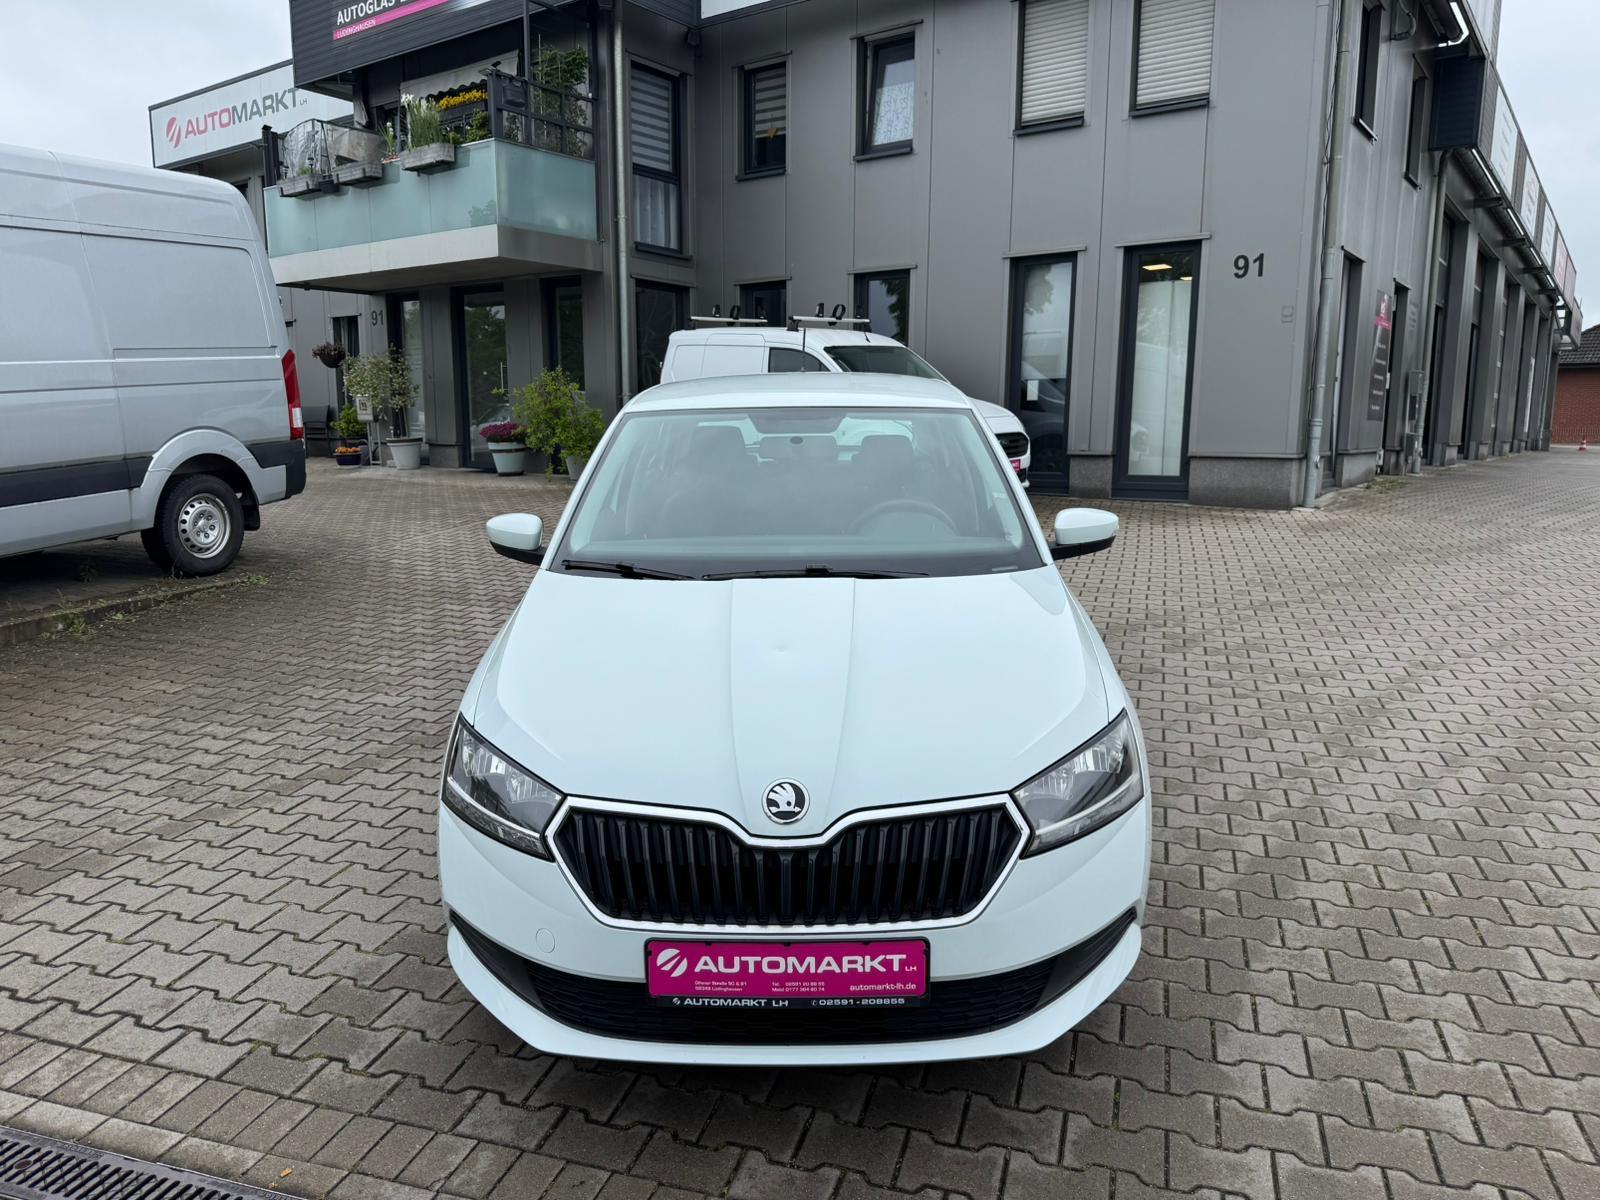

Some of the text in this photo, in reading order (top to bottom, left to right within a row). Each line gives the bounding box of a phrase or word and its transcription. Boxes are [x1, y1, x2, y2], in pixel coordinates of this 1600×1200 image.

[184, 88, 308, 139] AUTOMARKT LH
[1233, 253, 1265, 279] 91
[371, 310, 385, 326] 91
[694, 954, 907, 974] AUTOMARKT
[850, 982, 917, 991] automarkt-lh.de
[684, 998, 789, 1007] AUTOMARKT LH
